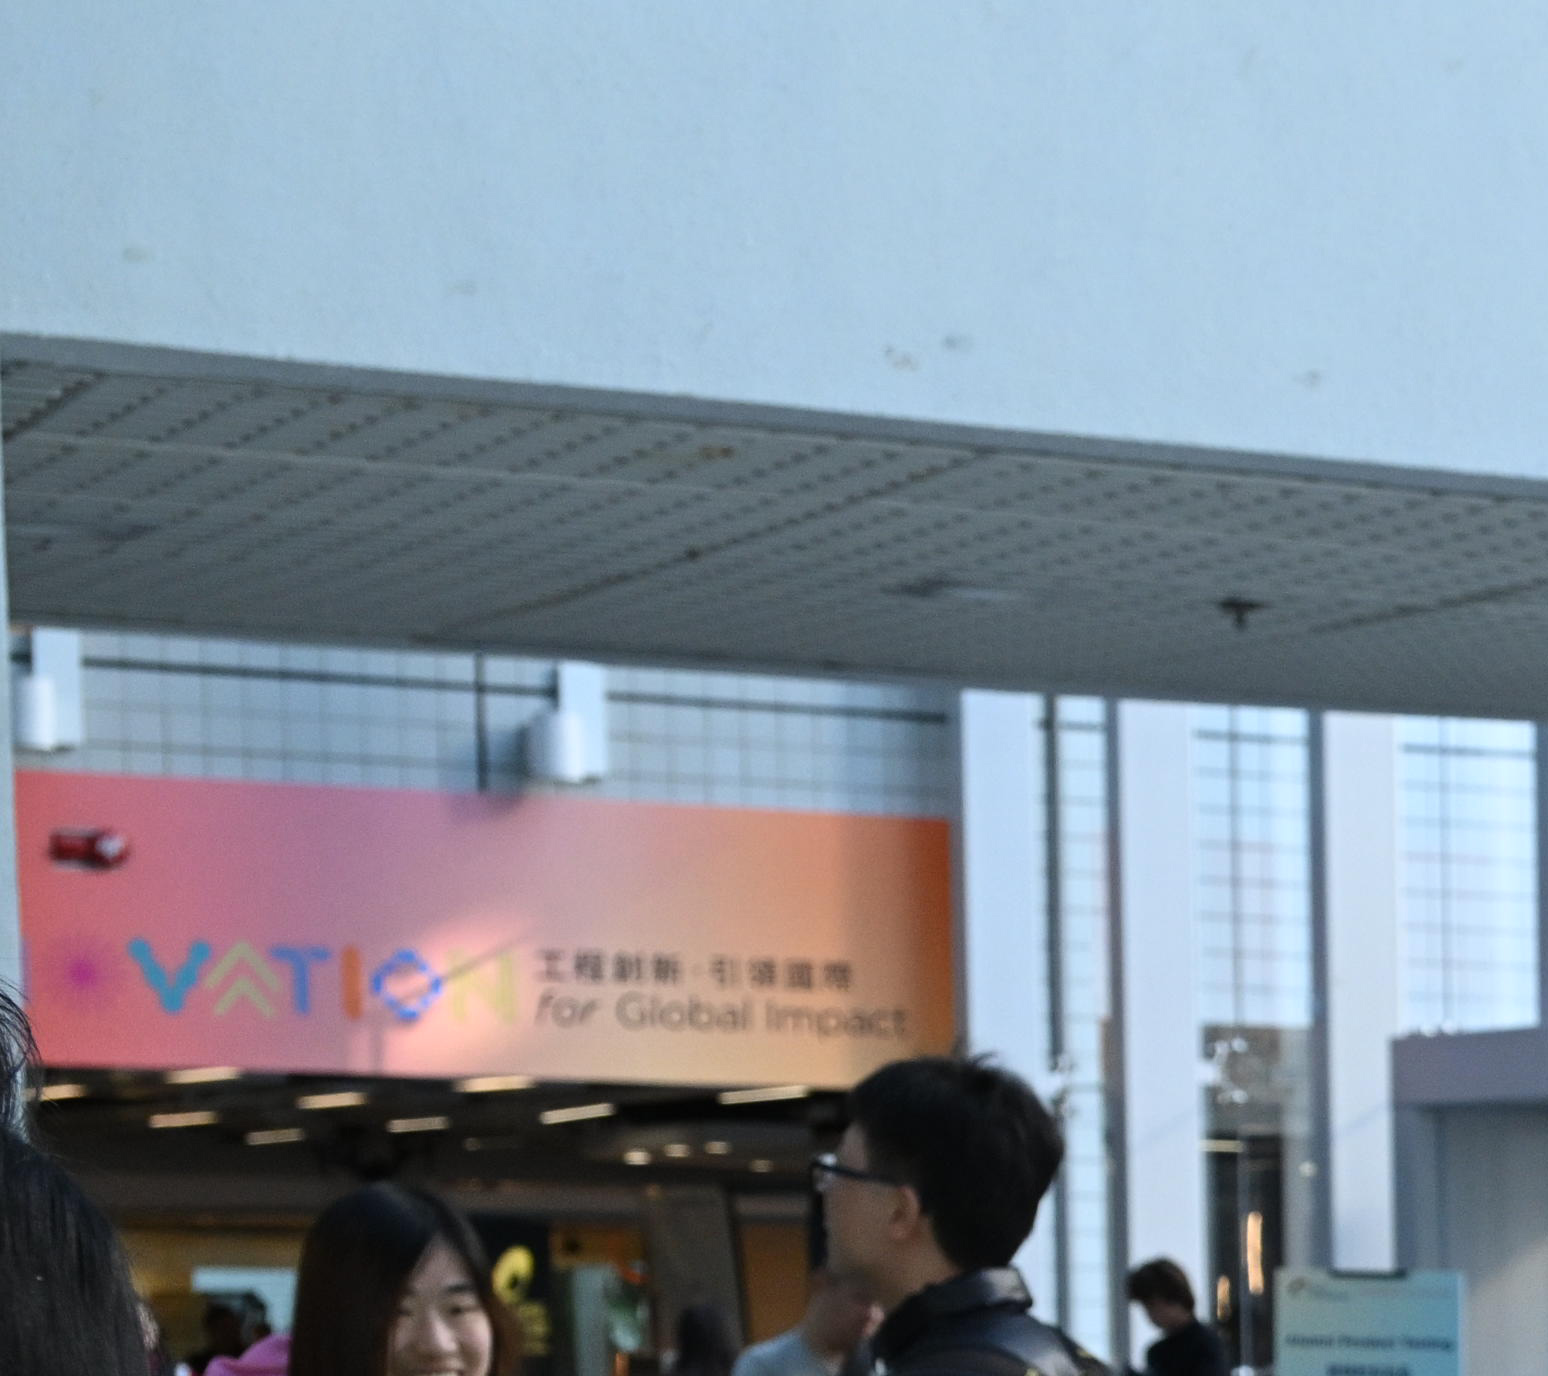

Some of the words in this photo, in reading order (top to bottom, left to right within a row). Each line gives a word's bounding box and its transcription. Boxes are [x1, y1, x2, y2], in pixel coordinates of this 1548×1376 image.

[534, 988, 597, 1029] for
[614, 990, 753, 1034] Global
[765, 1000, 905, 1042] Impact
